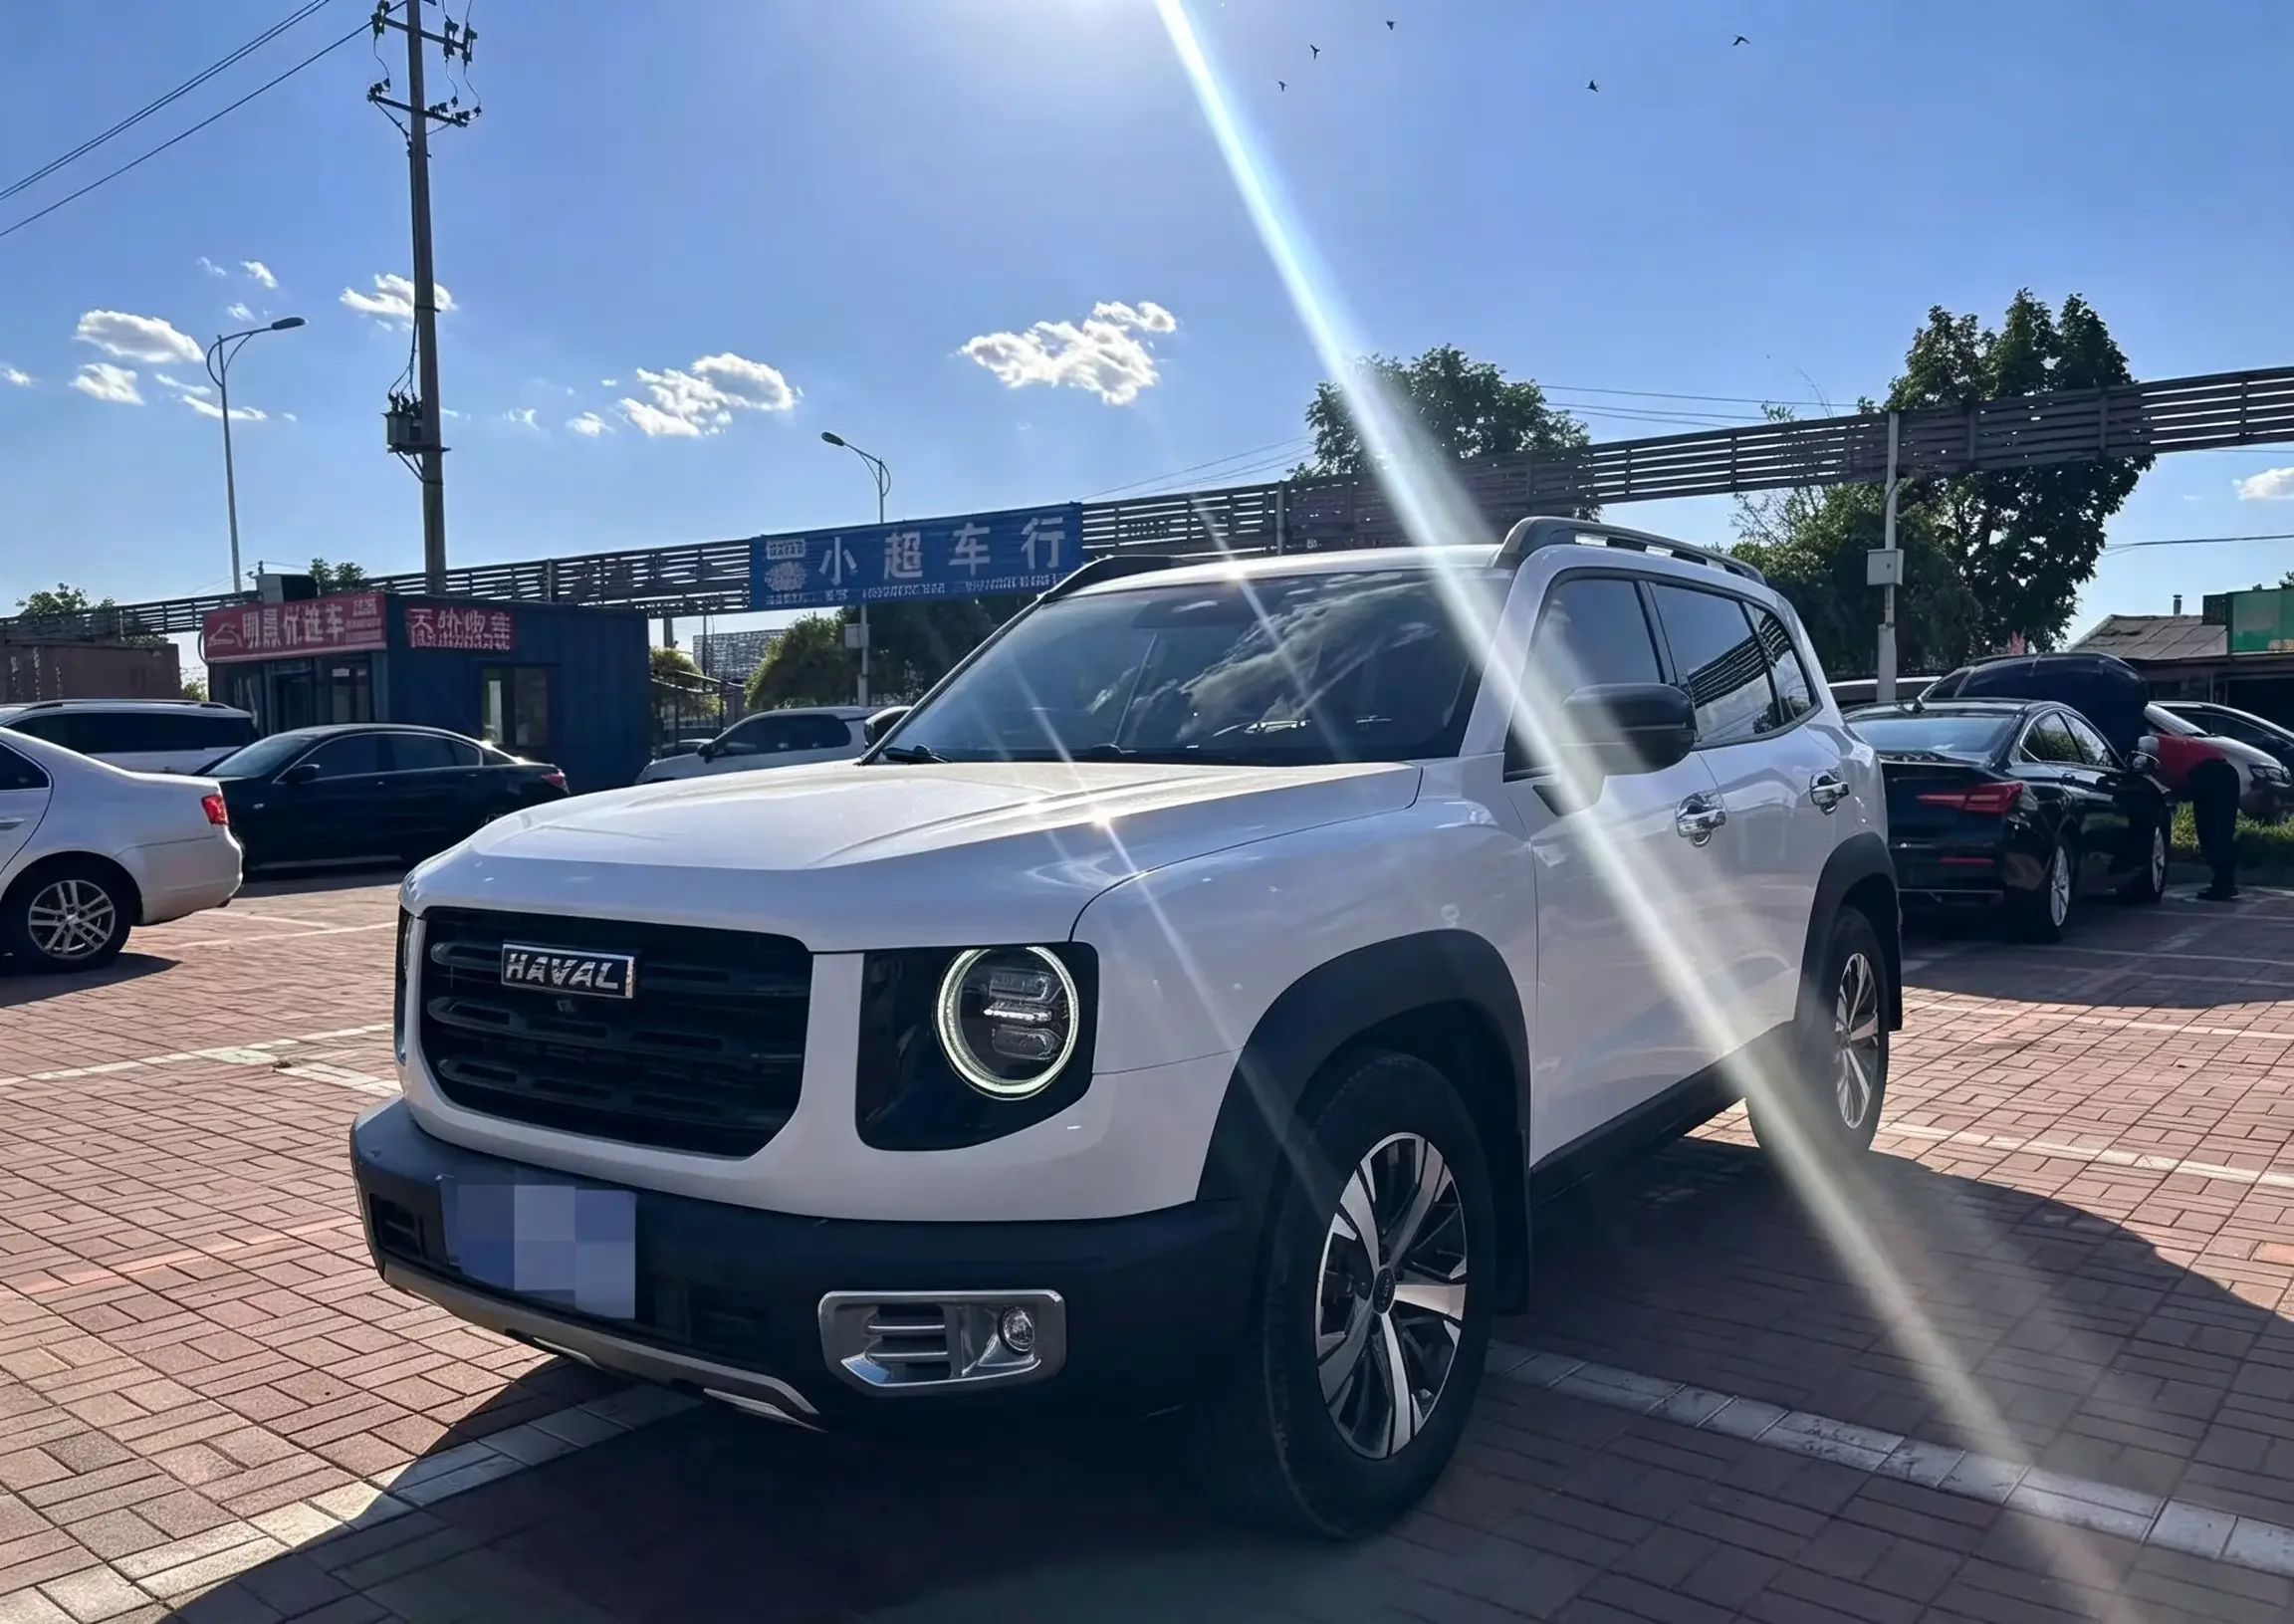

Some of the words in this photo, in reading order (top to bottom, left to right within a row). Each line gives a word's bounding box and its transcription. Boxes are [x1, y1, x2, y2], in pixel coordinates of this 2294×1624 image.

[818, 517, 1065, 585] 小超车行
[506, 953, 618, 990] HAVAL
